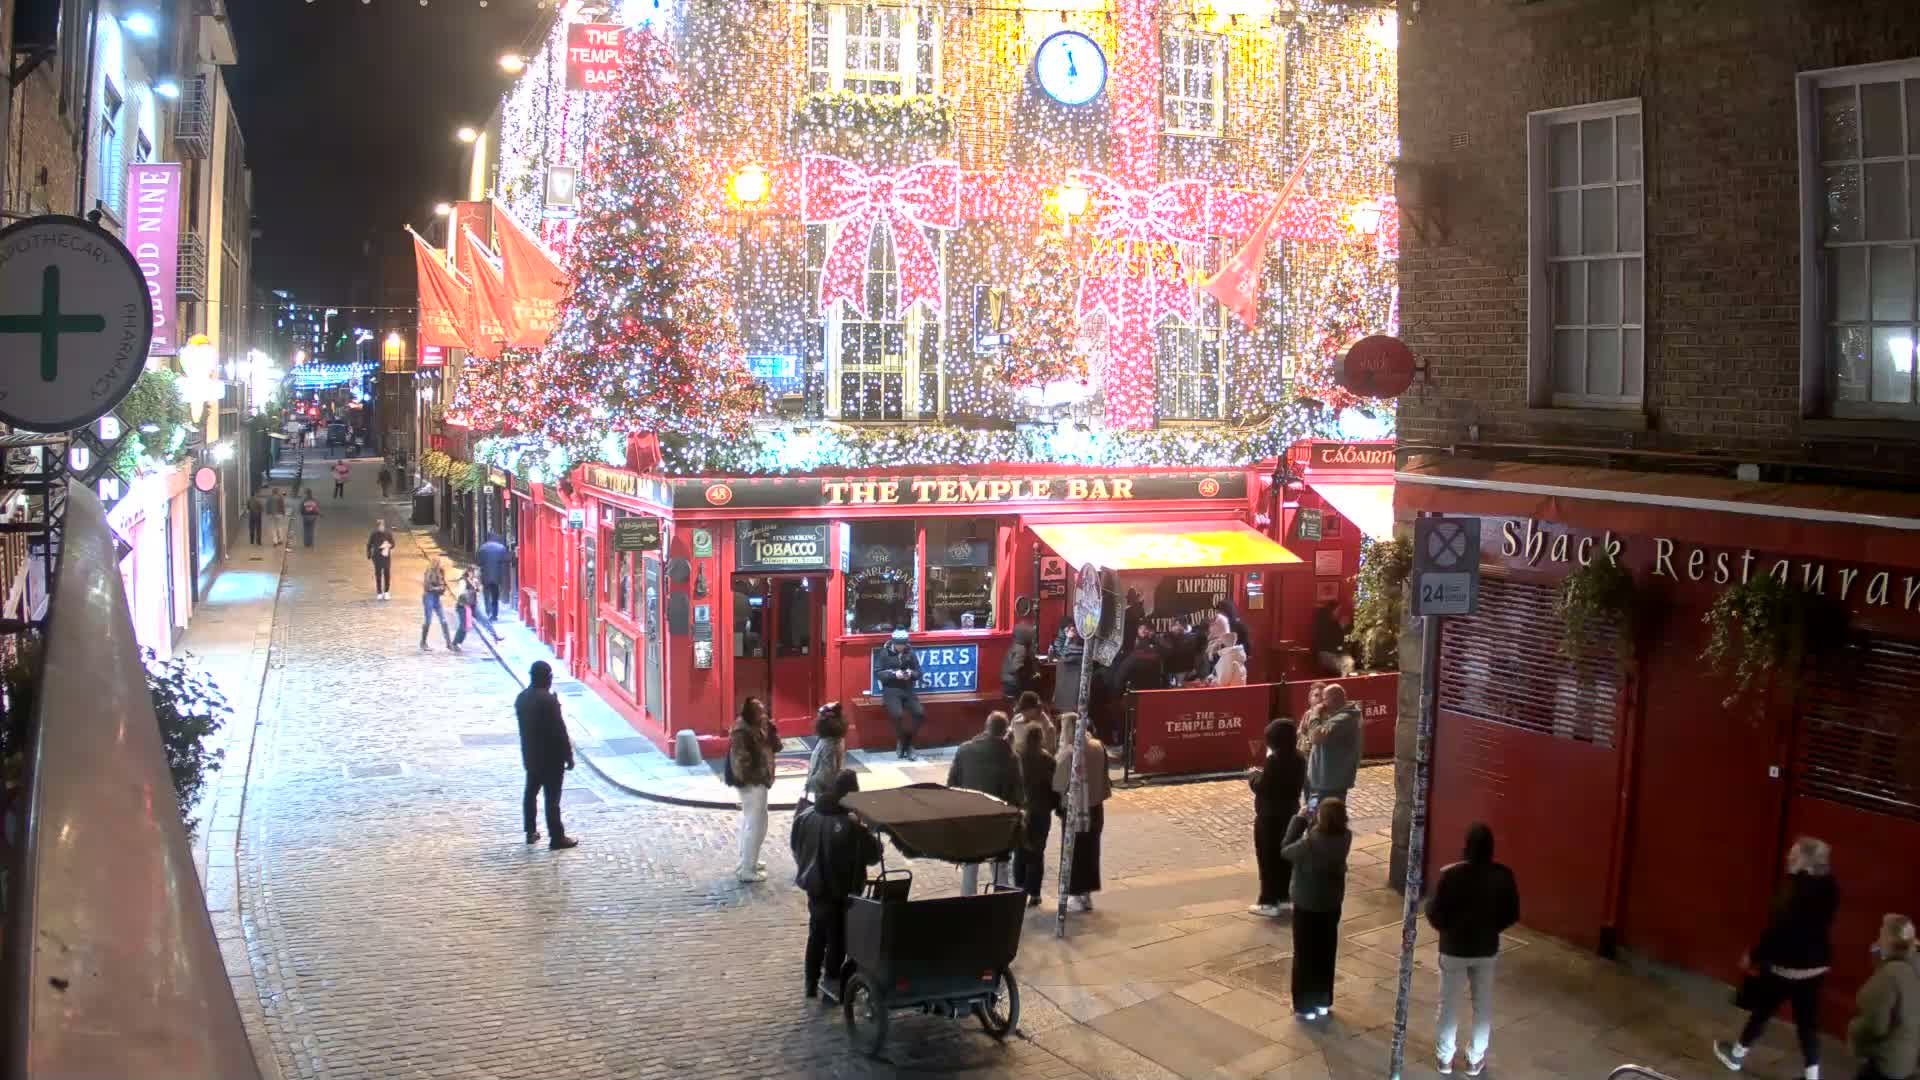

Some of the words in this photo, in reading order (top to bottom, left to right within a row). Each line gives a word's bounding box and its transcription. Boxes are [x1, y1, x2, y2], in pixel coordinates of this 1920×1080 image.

[585, 29, 618, 46] THE
[137, 171, 171, 233] NINE
[711, 487, 727, 500] 48
[823, 480, 900, 505] THE
[911, 478, 1052, 503] TEMPLE
[1065, 477, 1135, 501] BAR
[1501, 517, 1622, 567] Shack
[752, 539, 818, 563] TOBACCO
[1176, 578, 1228, 594] EMPEROR
[1423, 583, 1444, 603] 24
[1195, 711, 1215, 720] THE
[1365, 704, 1388, 717] BAR
[1166, 719, 1214, 733] TEMPLE
[1218, 716, 1243, 729] BAR
